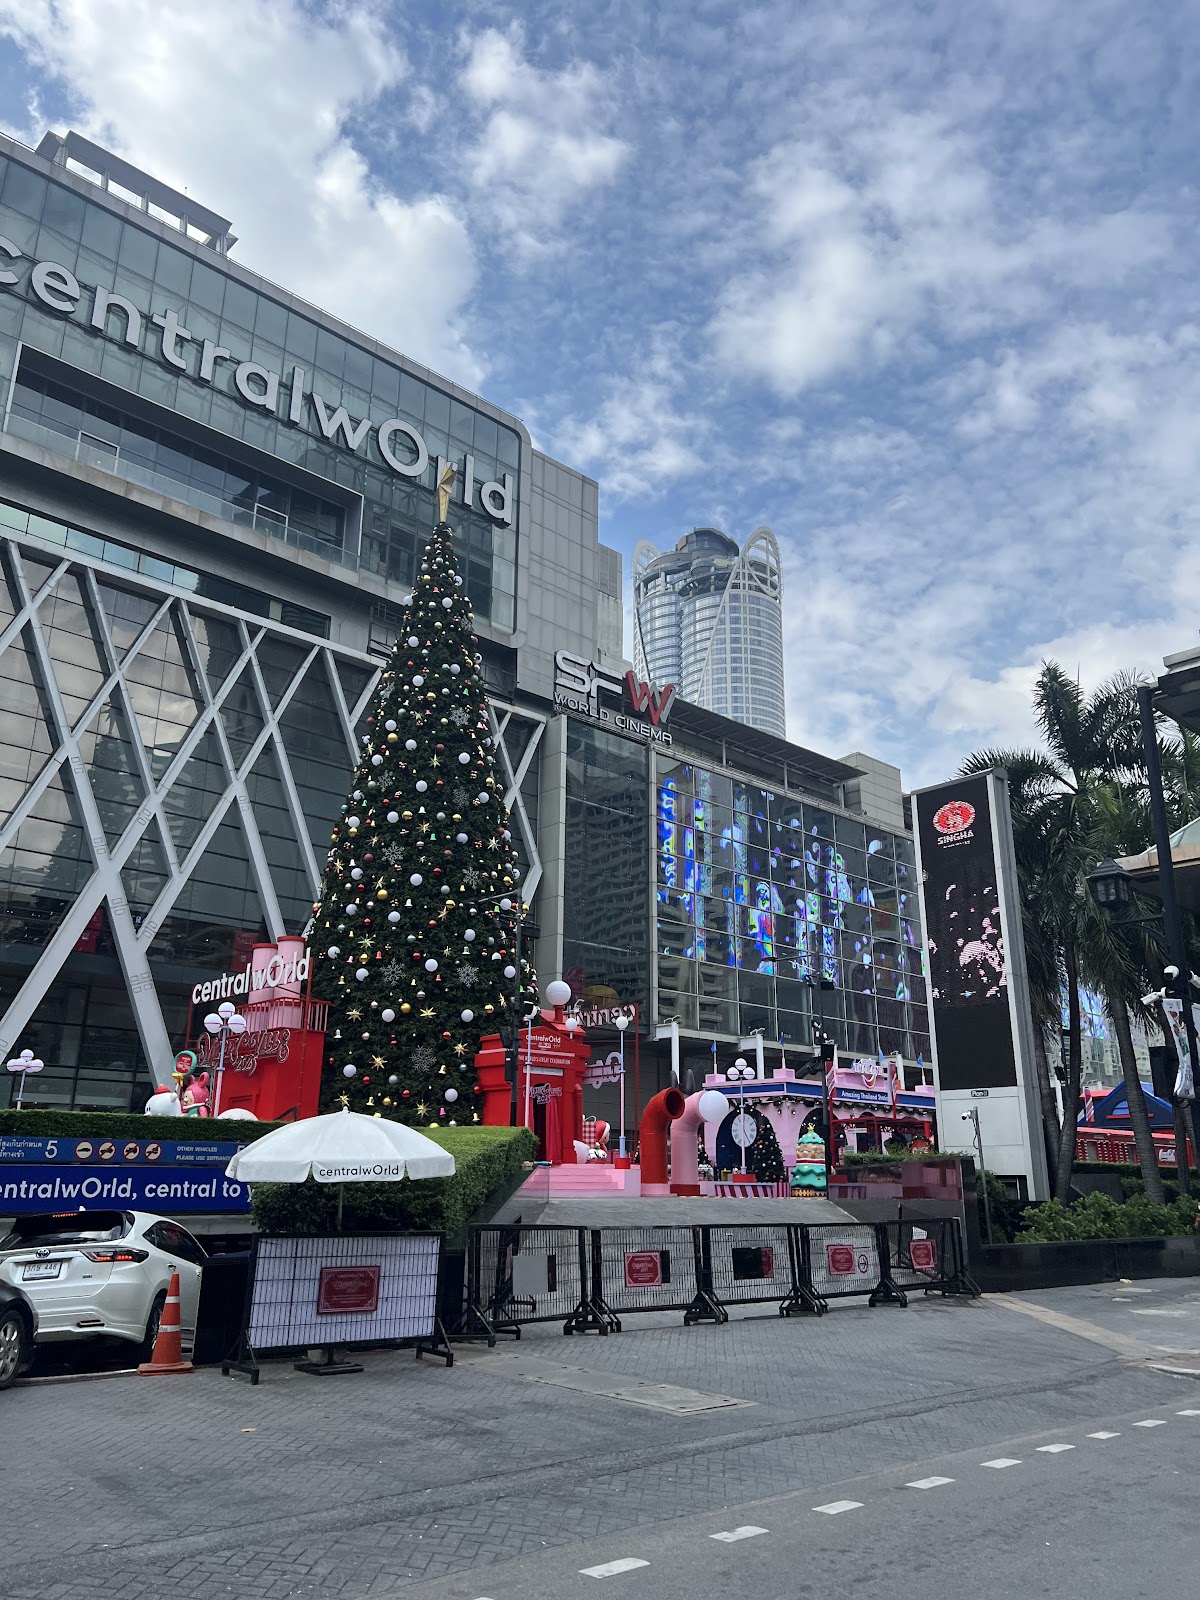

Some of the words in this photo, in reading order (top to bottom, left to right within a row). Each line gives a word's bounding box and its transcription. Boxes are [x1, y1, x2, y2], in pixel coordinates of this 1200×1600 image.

[553, 691, 610, 721] WORLD
[614, 715, 673, 745] CINEMA
[937, 829, 975, 846] SINGHA
[192, 946, 311, 1005] centralwOrld
[44, 1139, 58, 1159] 5
[319, 1164, 399, 1177] centralwOrld
[144, 1178, 217, 1198] central
[222, 1180, 241, 1198] to
